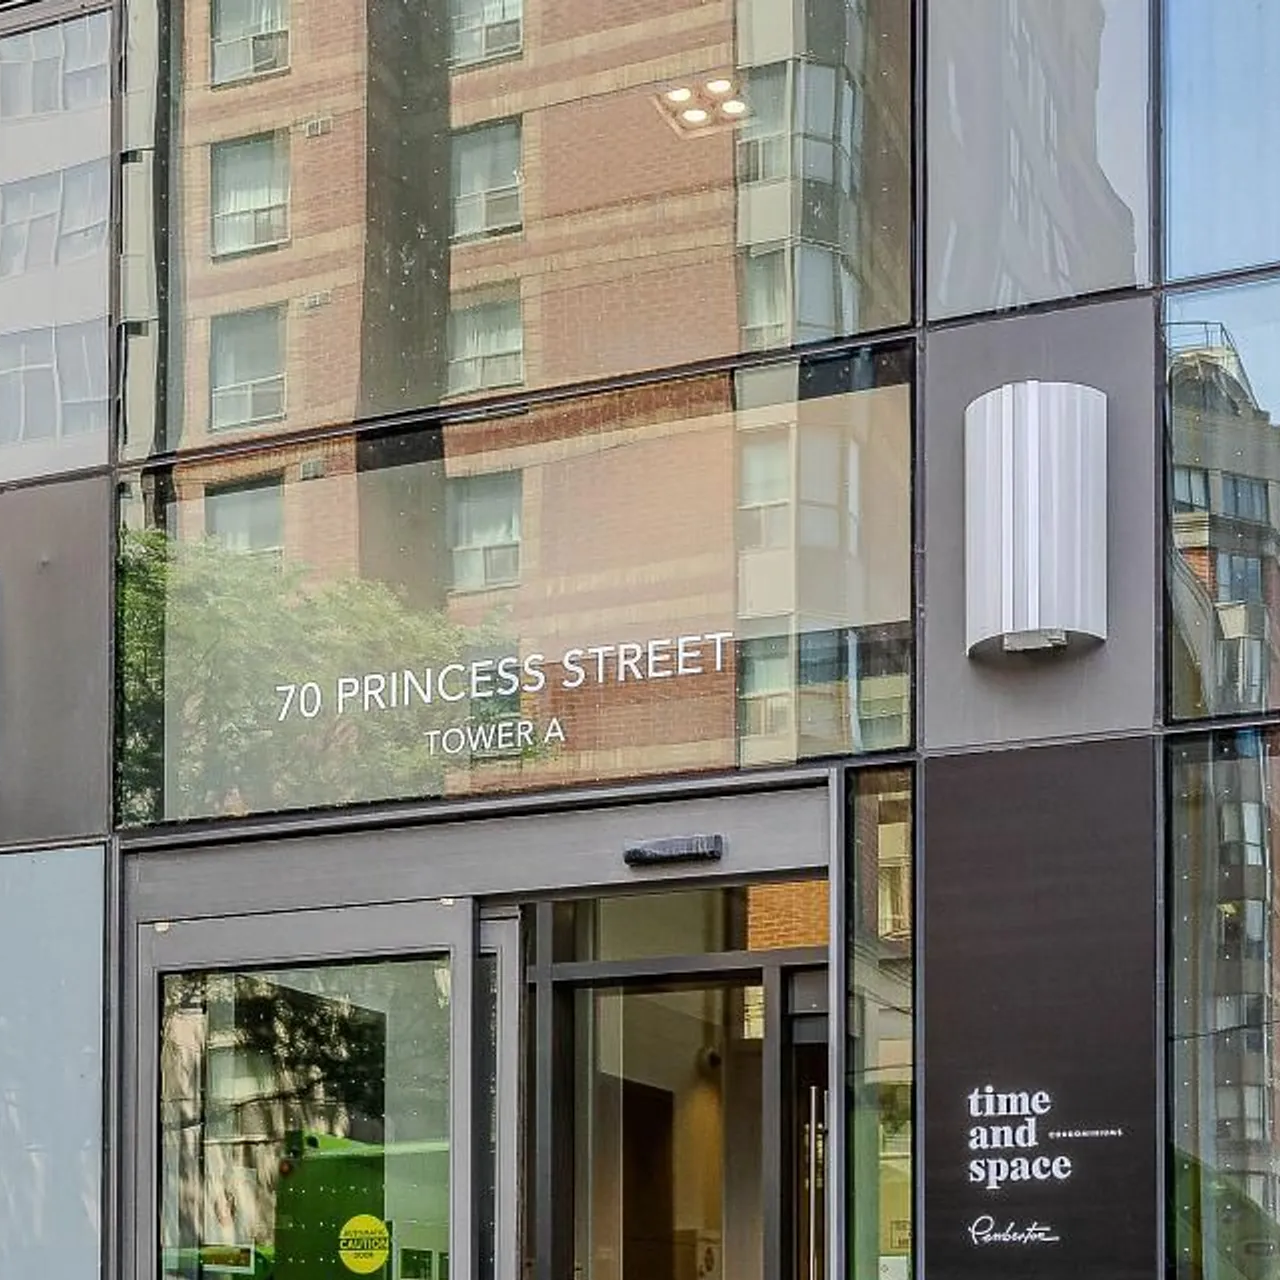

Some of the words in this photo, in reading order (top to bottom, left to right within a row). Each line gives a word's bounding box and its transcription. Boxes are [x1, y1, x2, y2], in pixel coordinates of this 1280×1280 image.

[275, 682, 322, 721] 70
[337, 653, 546, 715] PRINCESS
[562, 631, 734, 689] STREET
[424, 718, 534, 757] TOWER
[543, 717, 567, 744] A
[967, 1084, 1052, 1117] time
[968, 1116, 1039, 1150] and
[968, 1155, 1072, 1190] space
[339, 1238, 389, 1249] CAUTION
